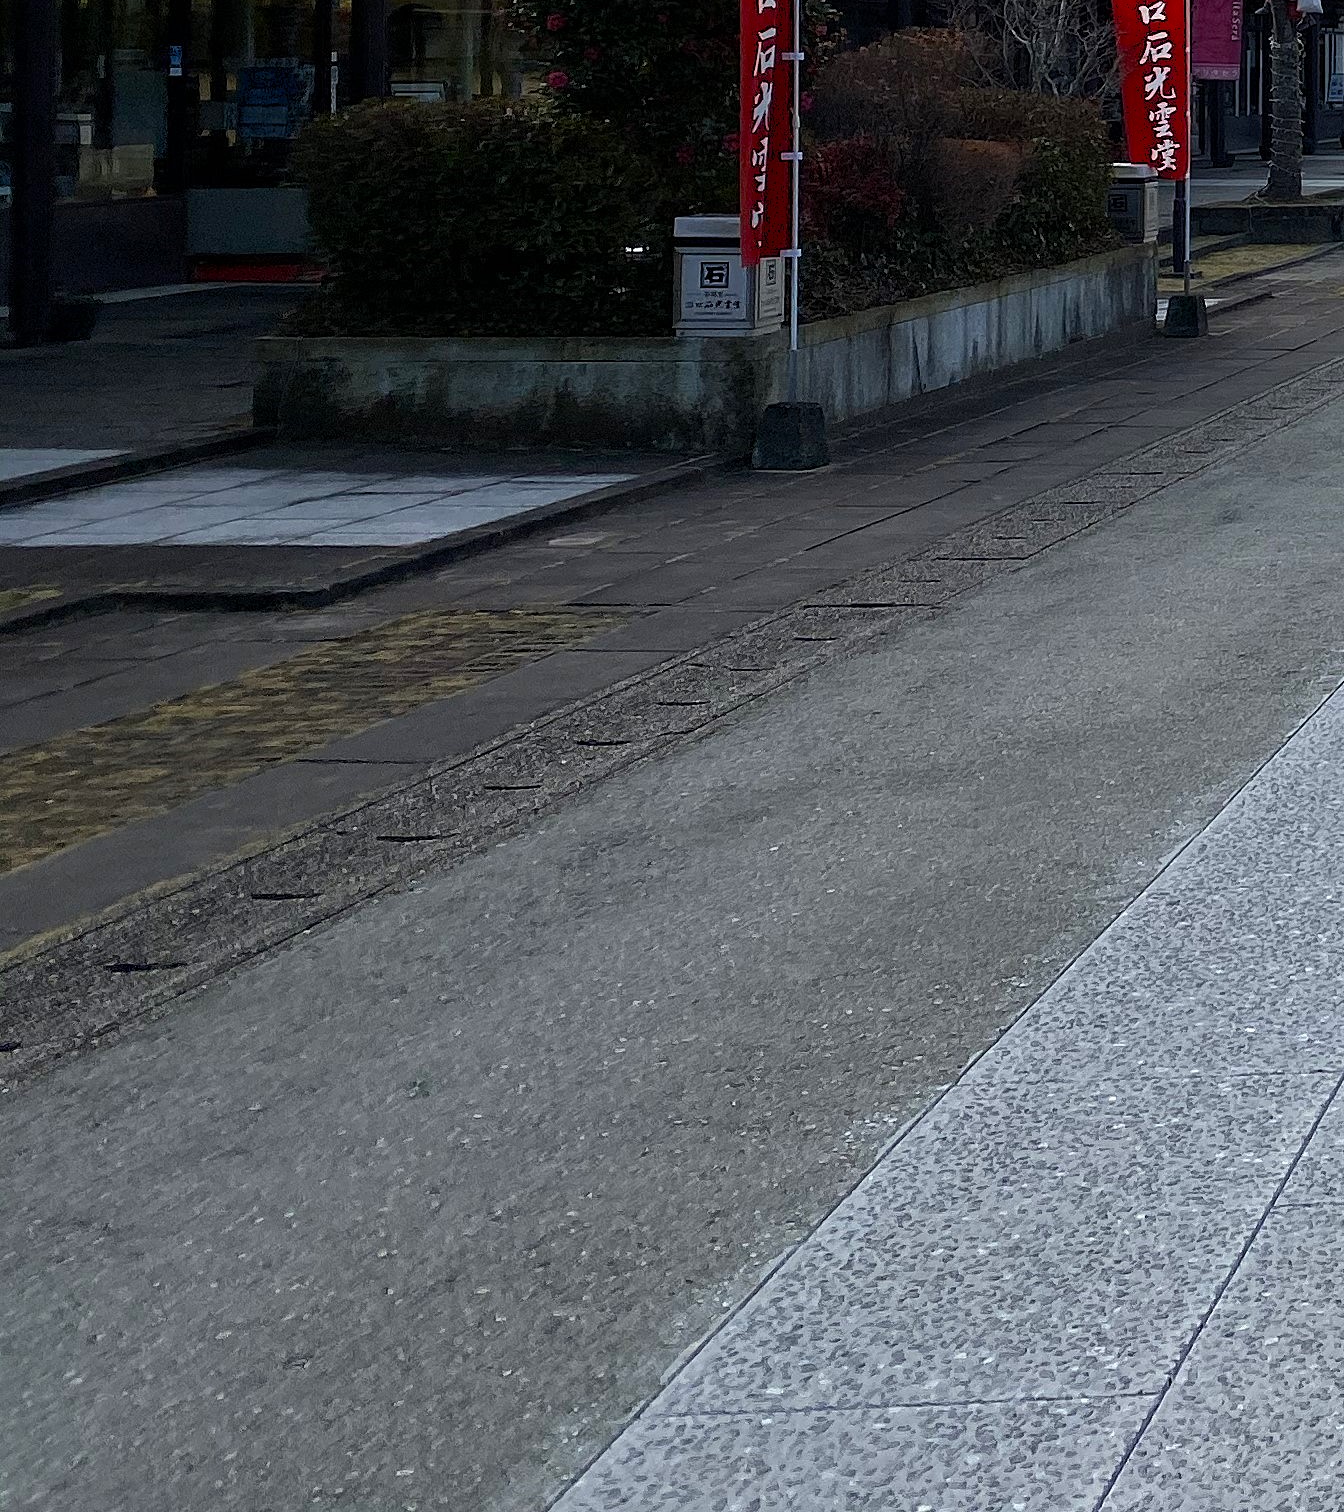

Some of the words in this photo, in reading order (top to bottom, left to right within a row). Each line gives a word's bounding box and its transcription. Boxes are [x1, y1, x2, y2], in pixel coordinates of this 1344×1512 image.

[1138, 0, 1180, 171] 口石光雲堂
